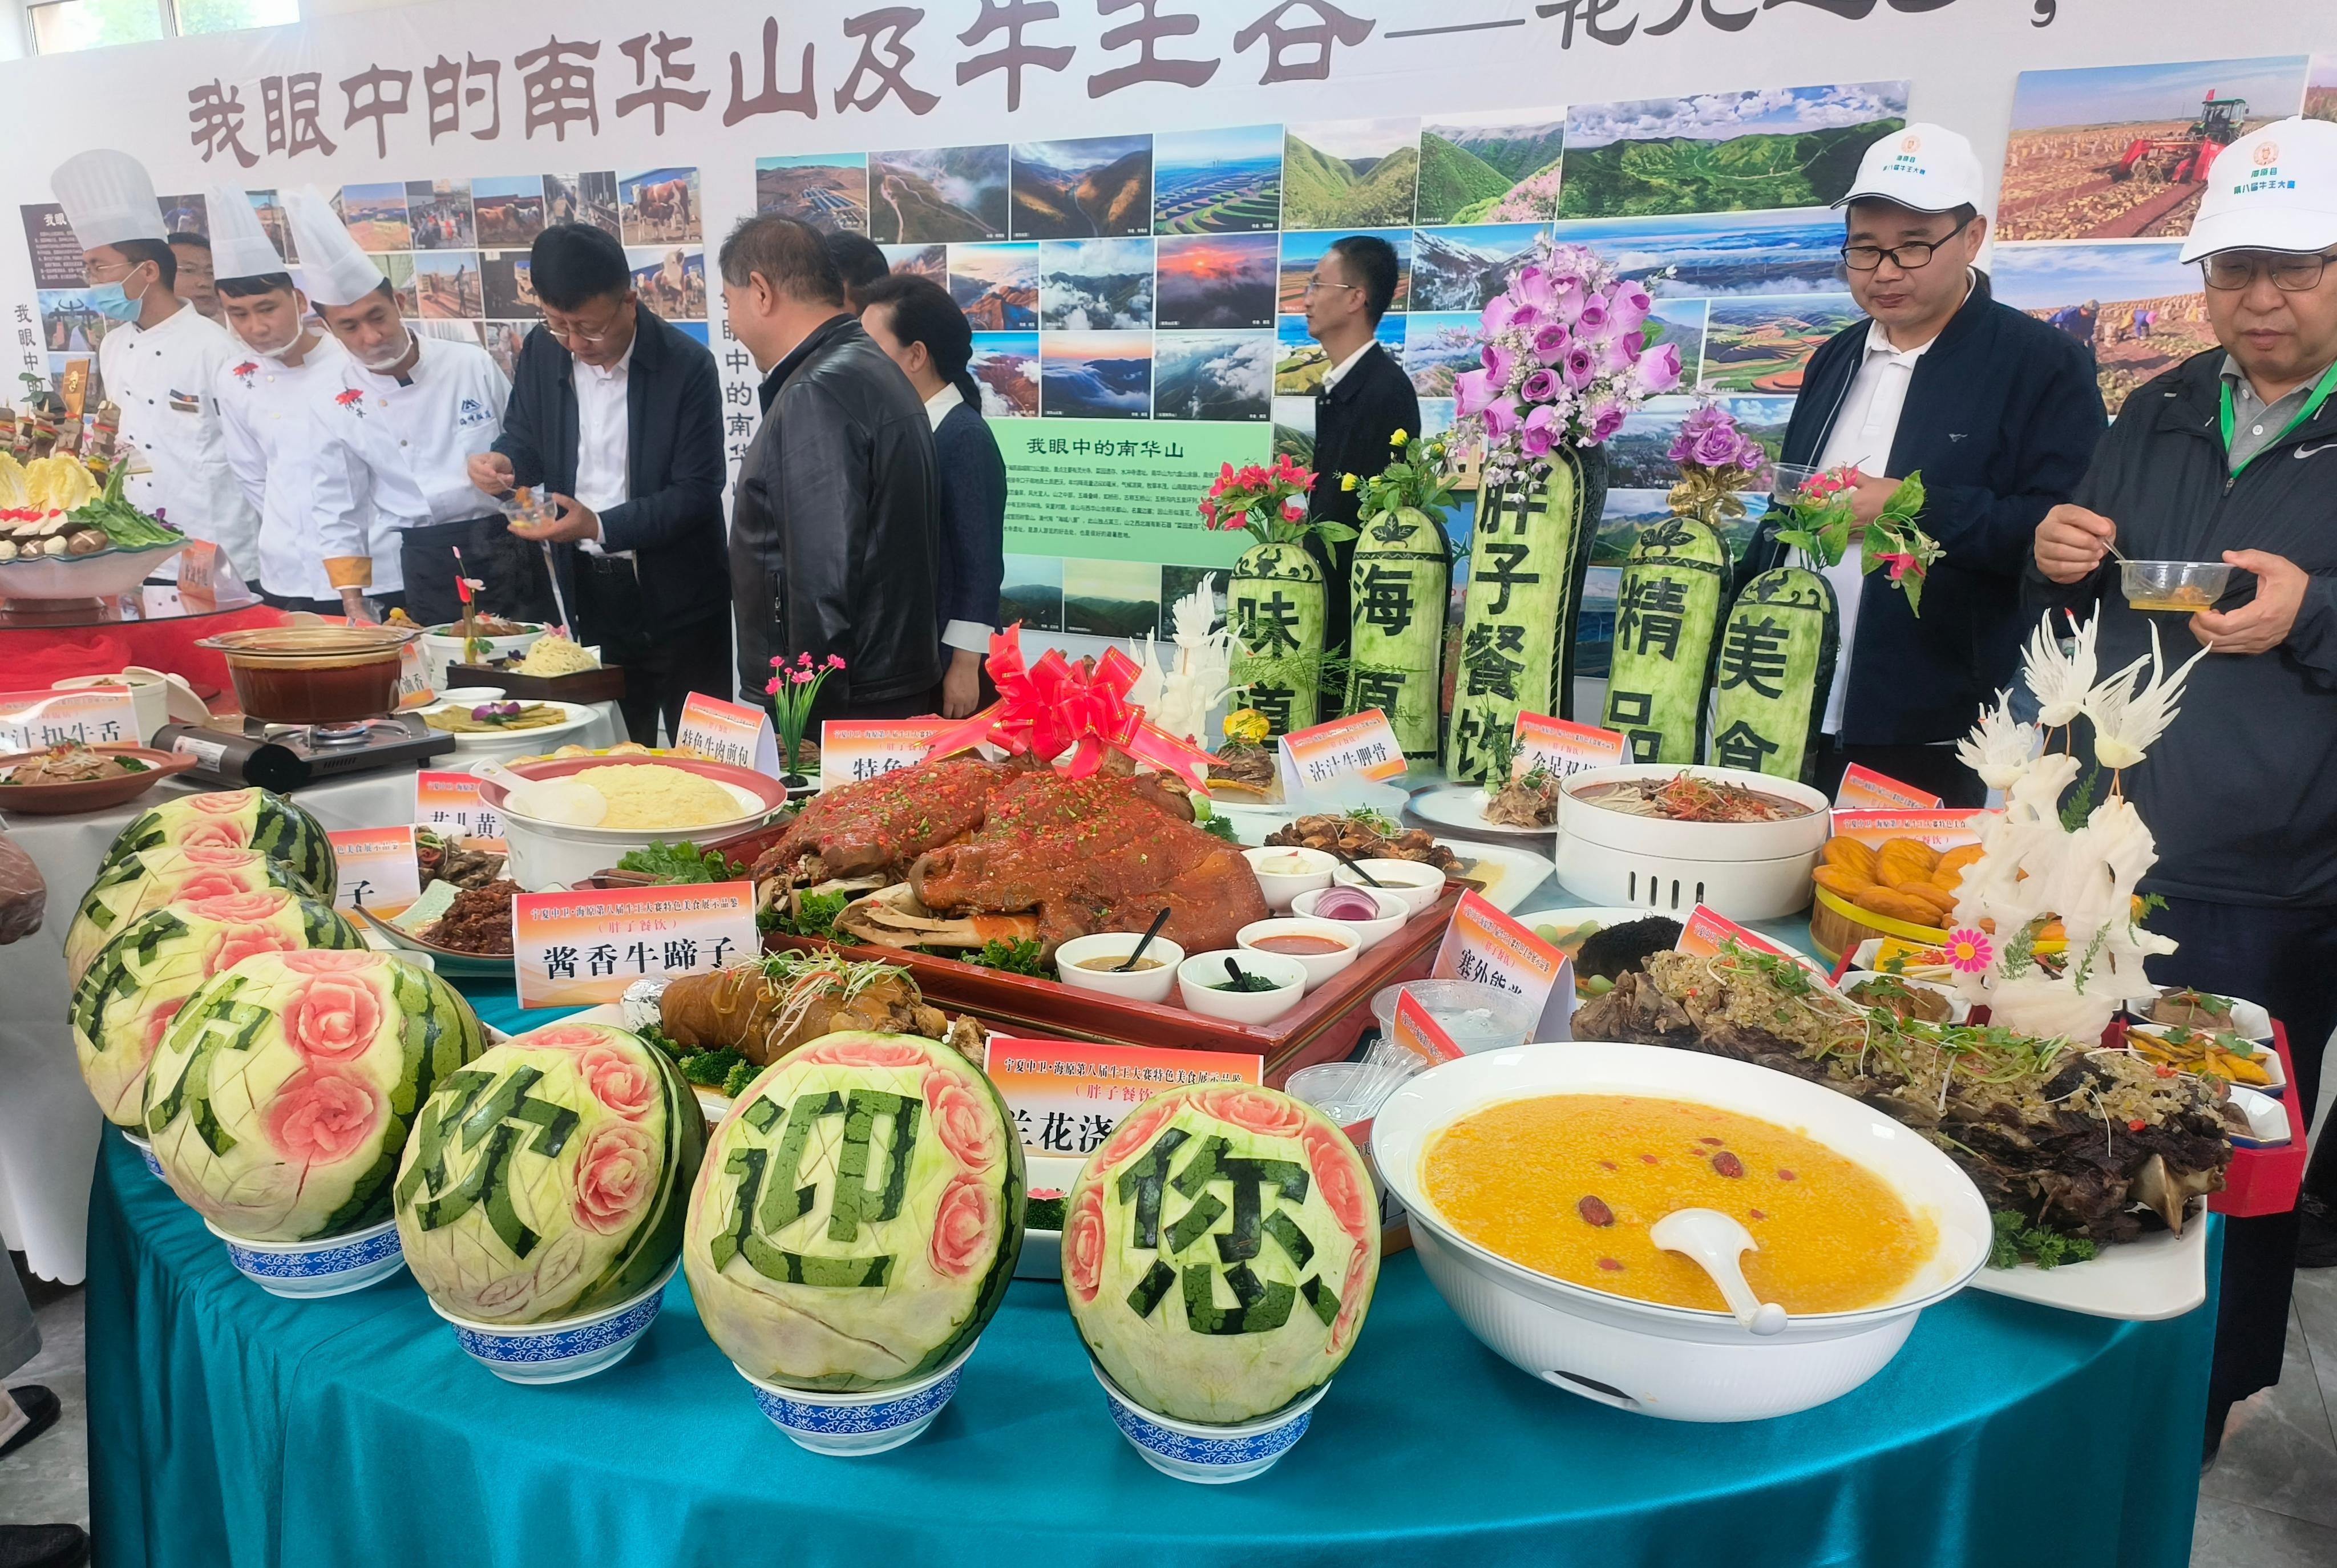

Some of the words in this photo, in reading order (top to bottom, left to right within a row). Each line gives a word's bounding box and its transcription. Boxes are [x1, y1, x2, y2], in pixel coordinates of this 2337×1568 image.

[1026, 438, 1184, 458] 我眼中的南华山
[1236, 591, 1301, 754] 味道
[1345, 563, 1414, 718] 海原
[1458, 465, 1552, 781] 胖子餐饮
[1603, 574, 1688, 763] 精品
[1715, 614, 1790, 772] 美食
[682, 728, 749, 768] 特色牛肉煎包
[853, 758, 922, 781] 特色
[339, 880, 375, 909] 子
[531, 897, 739, 921] 宁夏中卫·海原第八届牛王大赛特色美食展示品鉴
[543, 936, 736, 980] 酱香牛蹄子
[1075, 1082, 1164, 1102] （胖子餐饮
[711, 1089, 923, 1288] 迎
[1118, 1127, 1341, 1335] 您
